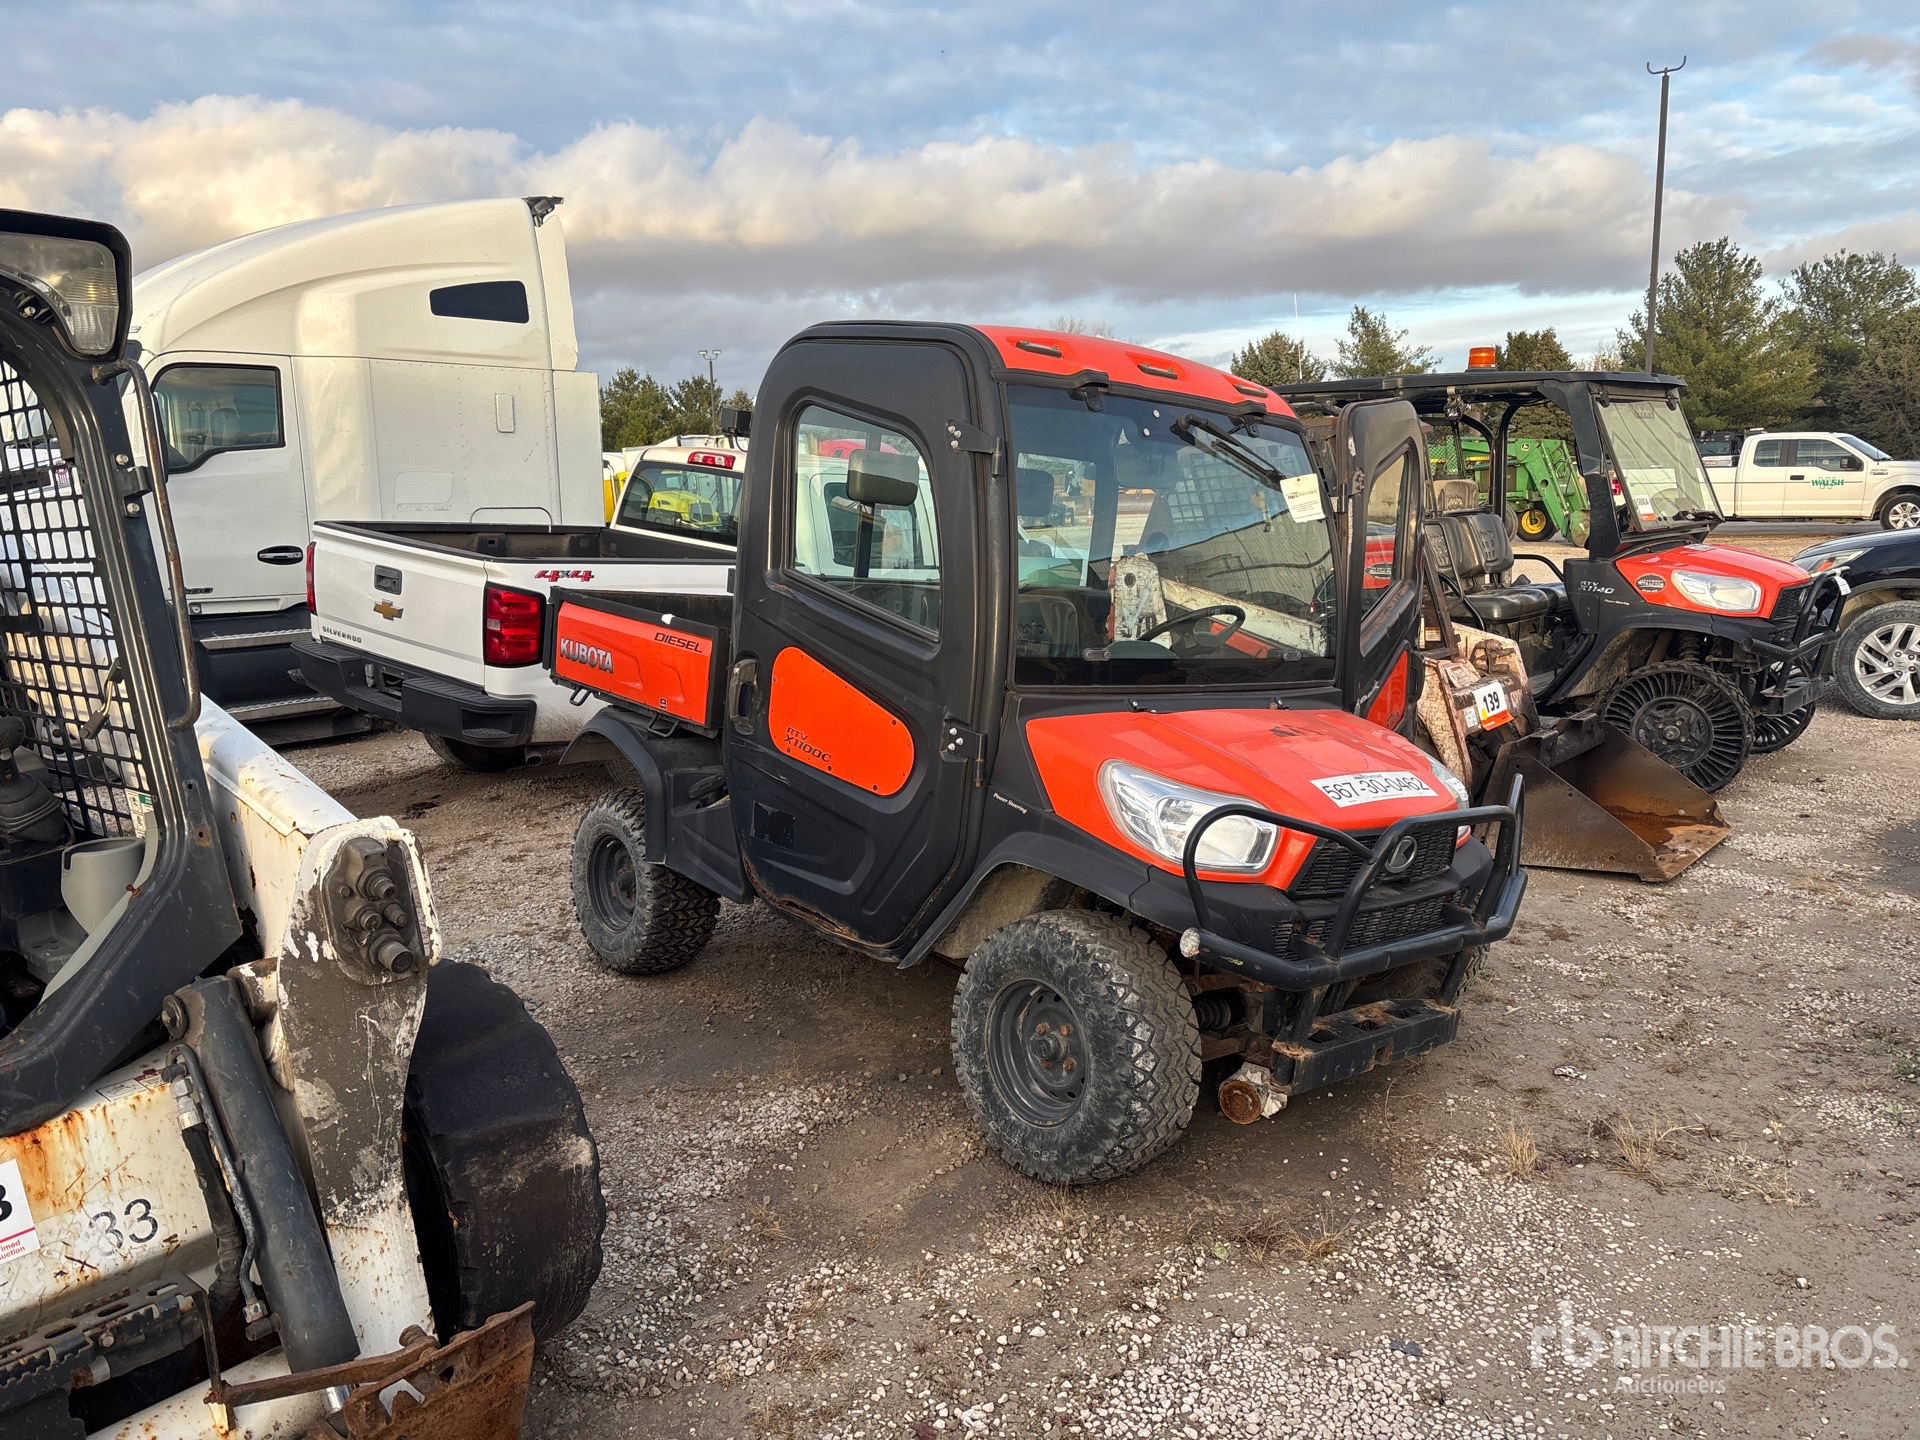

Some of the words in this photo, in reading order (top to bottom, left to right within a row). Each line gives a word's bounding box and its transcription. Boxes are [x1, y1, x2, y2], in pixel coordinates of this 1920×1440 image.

[1811, 479, 1844, 487] WALSH
[1578, 585, 1615, 594] X1140
[322, 626, 362, 643] SILVERADO
[654, 632, 703, 653] DIESEL
[560, 637, 614, 674] KUBOTA
[1483, 691, 1500, 713] 139
[787, 727, 808, 741] RTV
[784, 734, 832, 762] X1100C
[1321, 777, 1430, 800] 567-30-0462
[0, 1239, 21, 1252] imed
